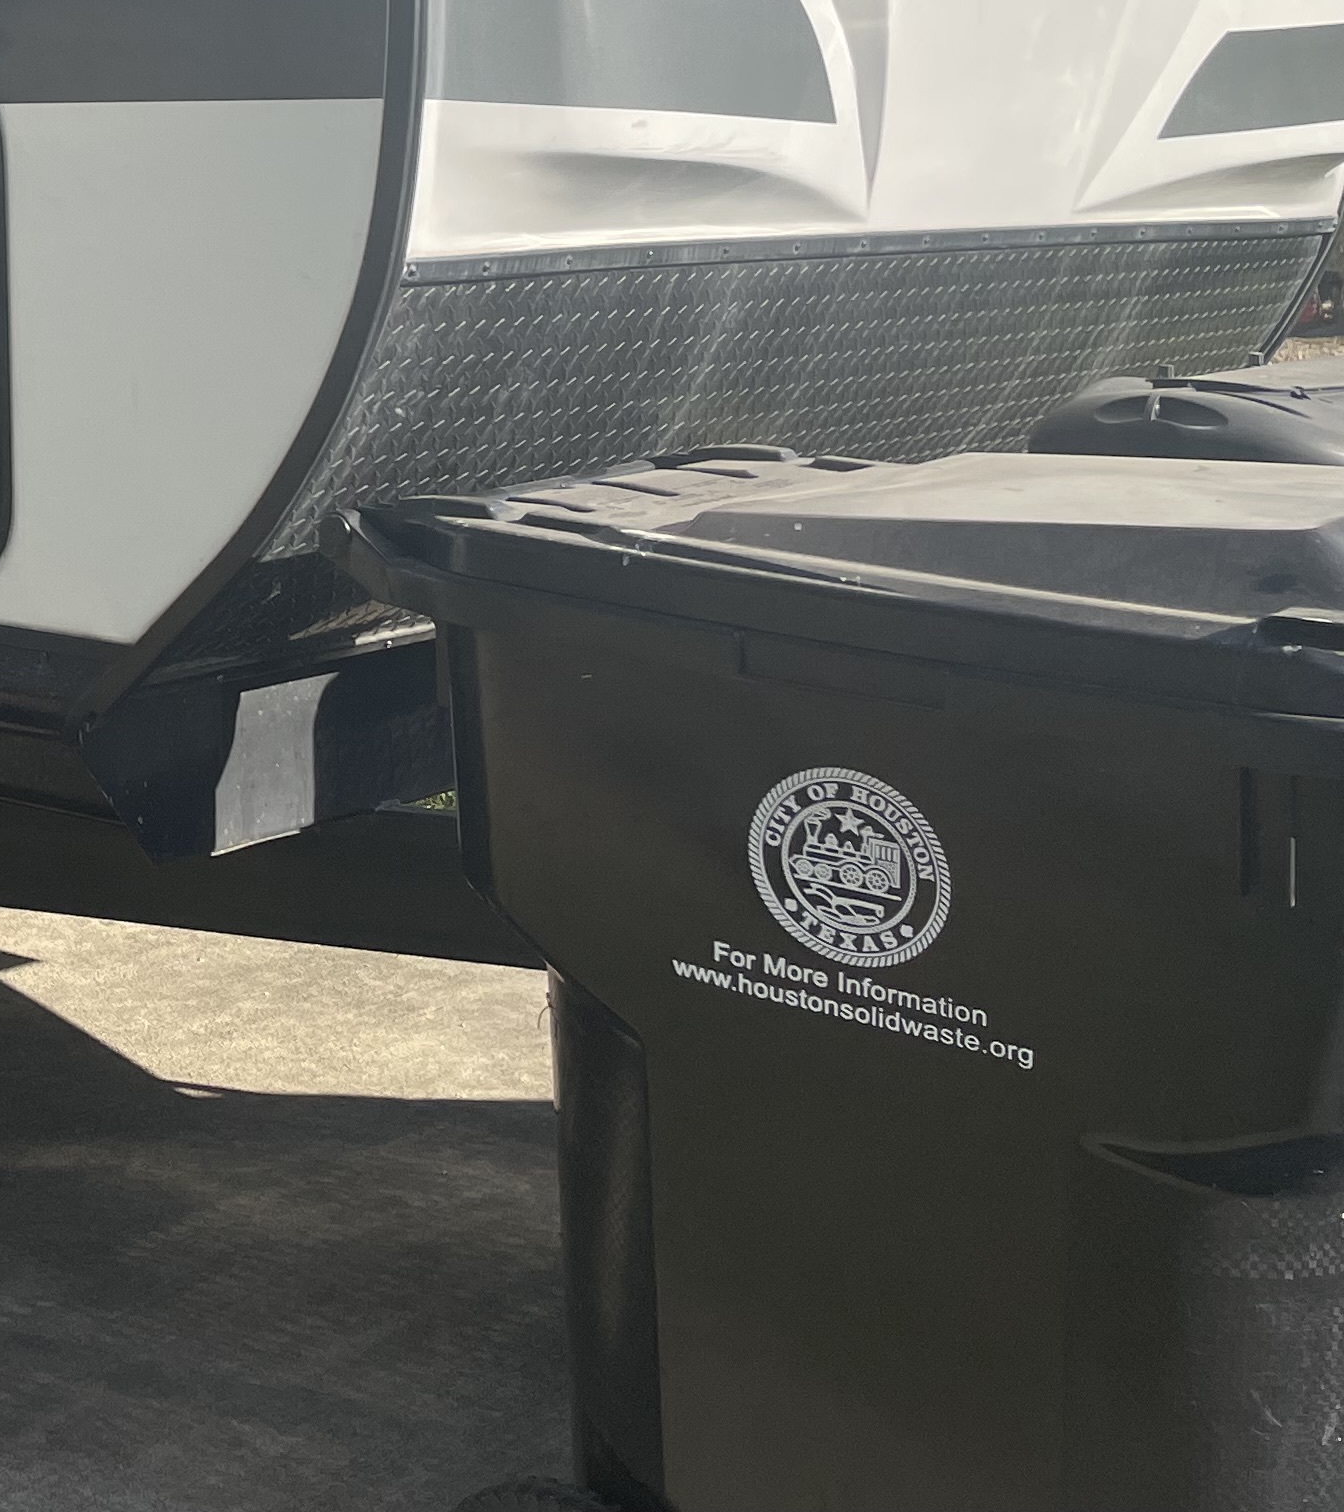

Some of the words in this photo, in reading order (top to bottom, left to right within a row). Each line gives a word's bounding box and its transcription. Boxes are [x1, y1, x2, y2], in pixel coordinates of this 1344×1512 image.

[765, 794, 802, 847] CITY
[806, 783, 839, 800] OF
[850, 785, 935, 882] HOUSTON
[799, 911, 899, 952] TEXAS
[671, 958, 1035, 1070] www.houstonsolidwaste.org
[713, 940, 757, 971] For
[763, 952, 829, 988] More
[838, 971, 988, 1027] Information
